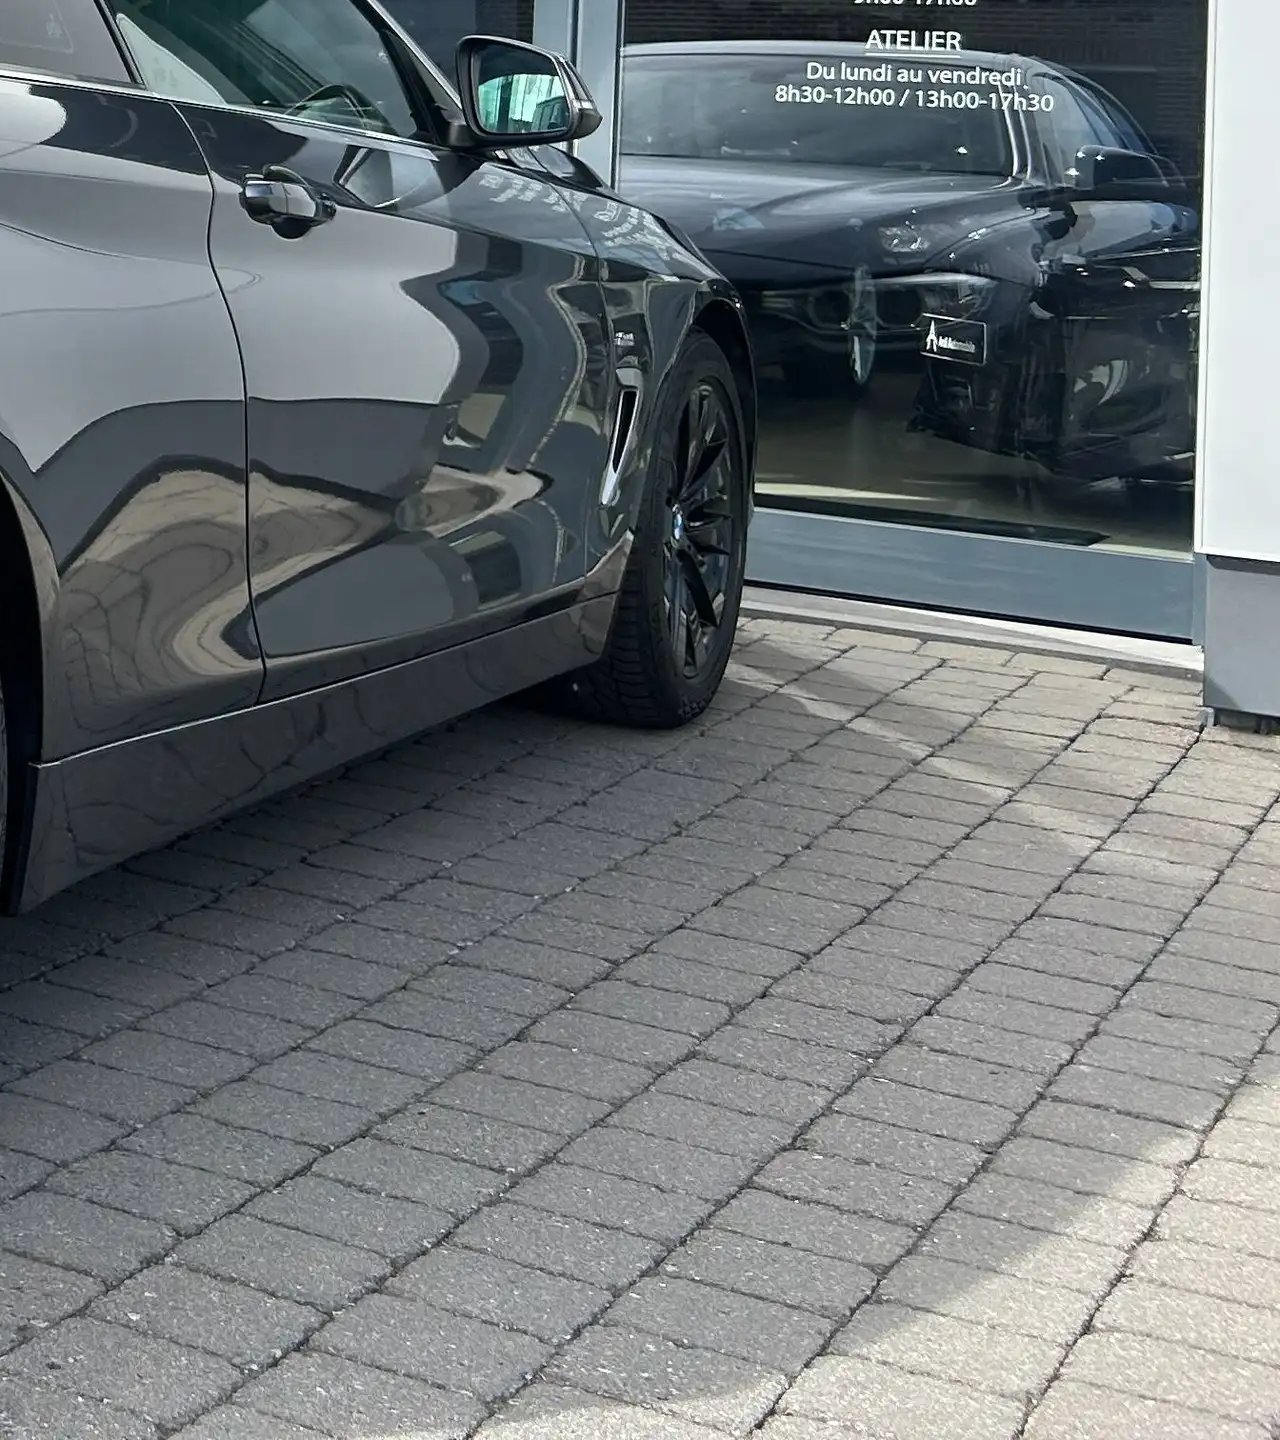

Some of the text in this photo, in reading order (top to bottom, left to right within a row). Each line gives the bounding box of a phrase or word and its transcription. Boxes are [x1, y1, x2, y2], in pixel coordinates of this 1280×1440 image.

[865, 30, 962, 51] ATELIER
[806, 61, 1022, 87] Du lundi au vendredi
[774, 83, 896, 107] 8h30-12h00
[915, 89, 1055, 112] 13h00-17h30
